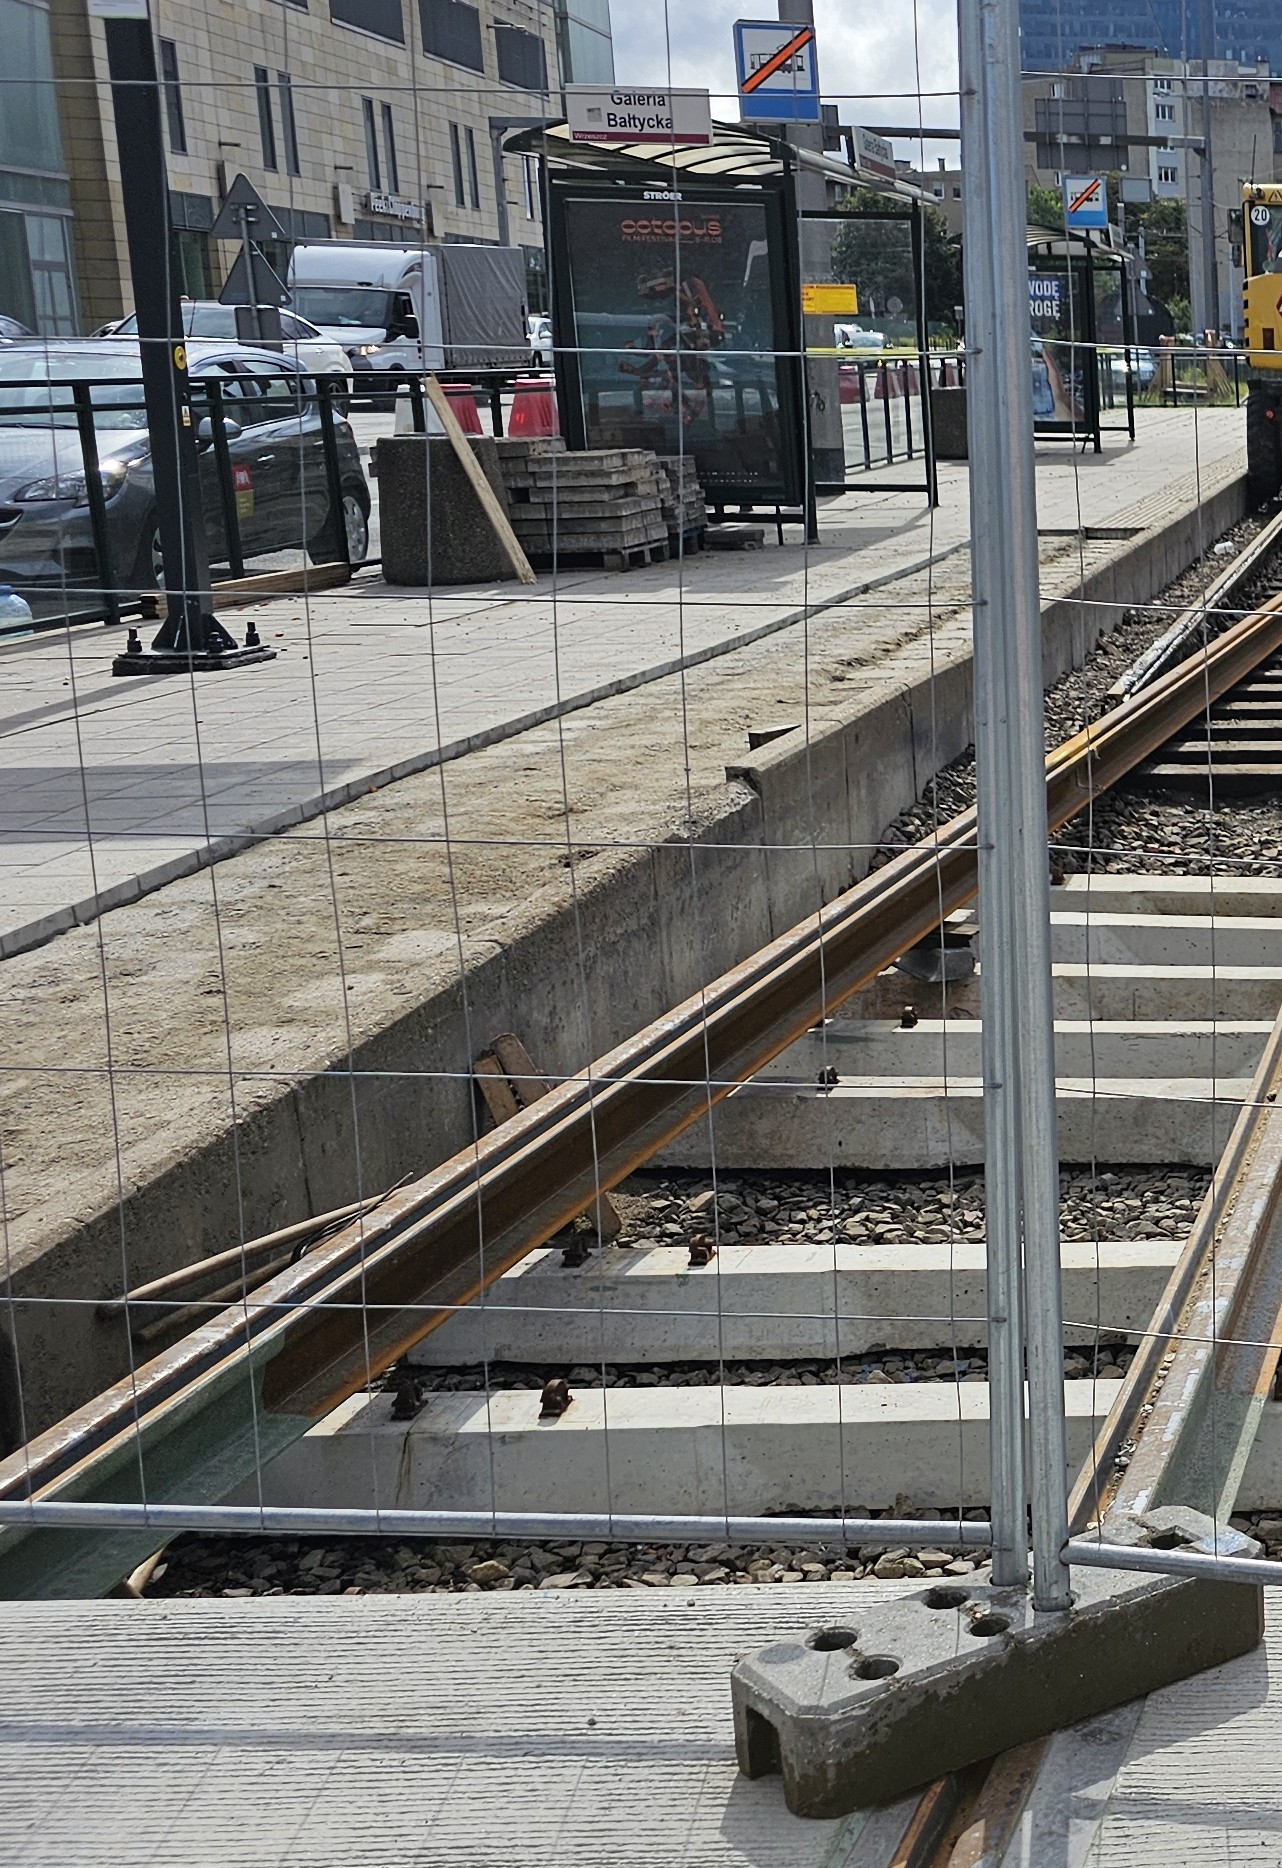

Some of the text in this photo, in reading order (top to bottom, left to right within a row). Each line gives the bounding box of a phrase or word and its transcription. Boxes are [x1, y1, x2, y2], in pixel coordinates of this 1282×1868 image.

[610, 90, 666, 107] Galeria
[606, 112, 674, 132] Bałtycka
[1254, 208, 1267, 222] 20
